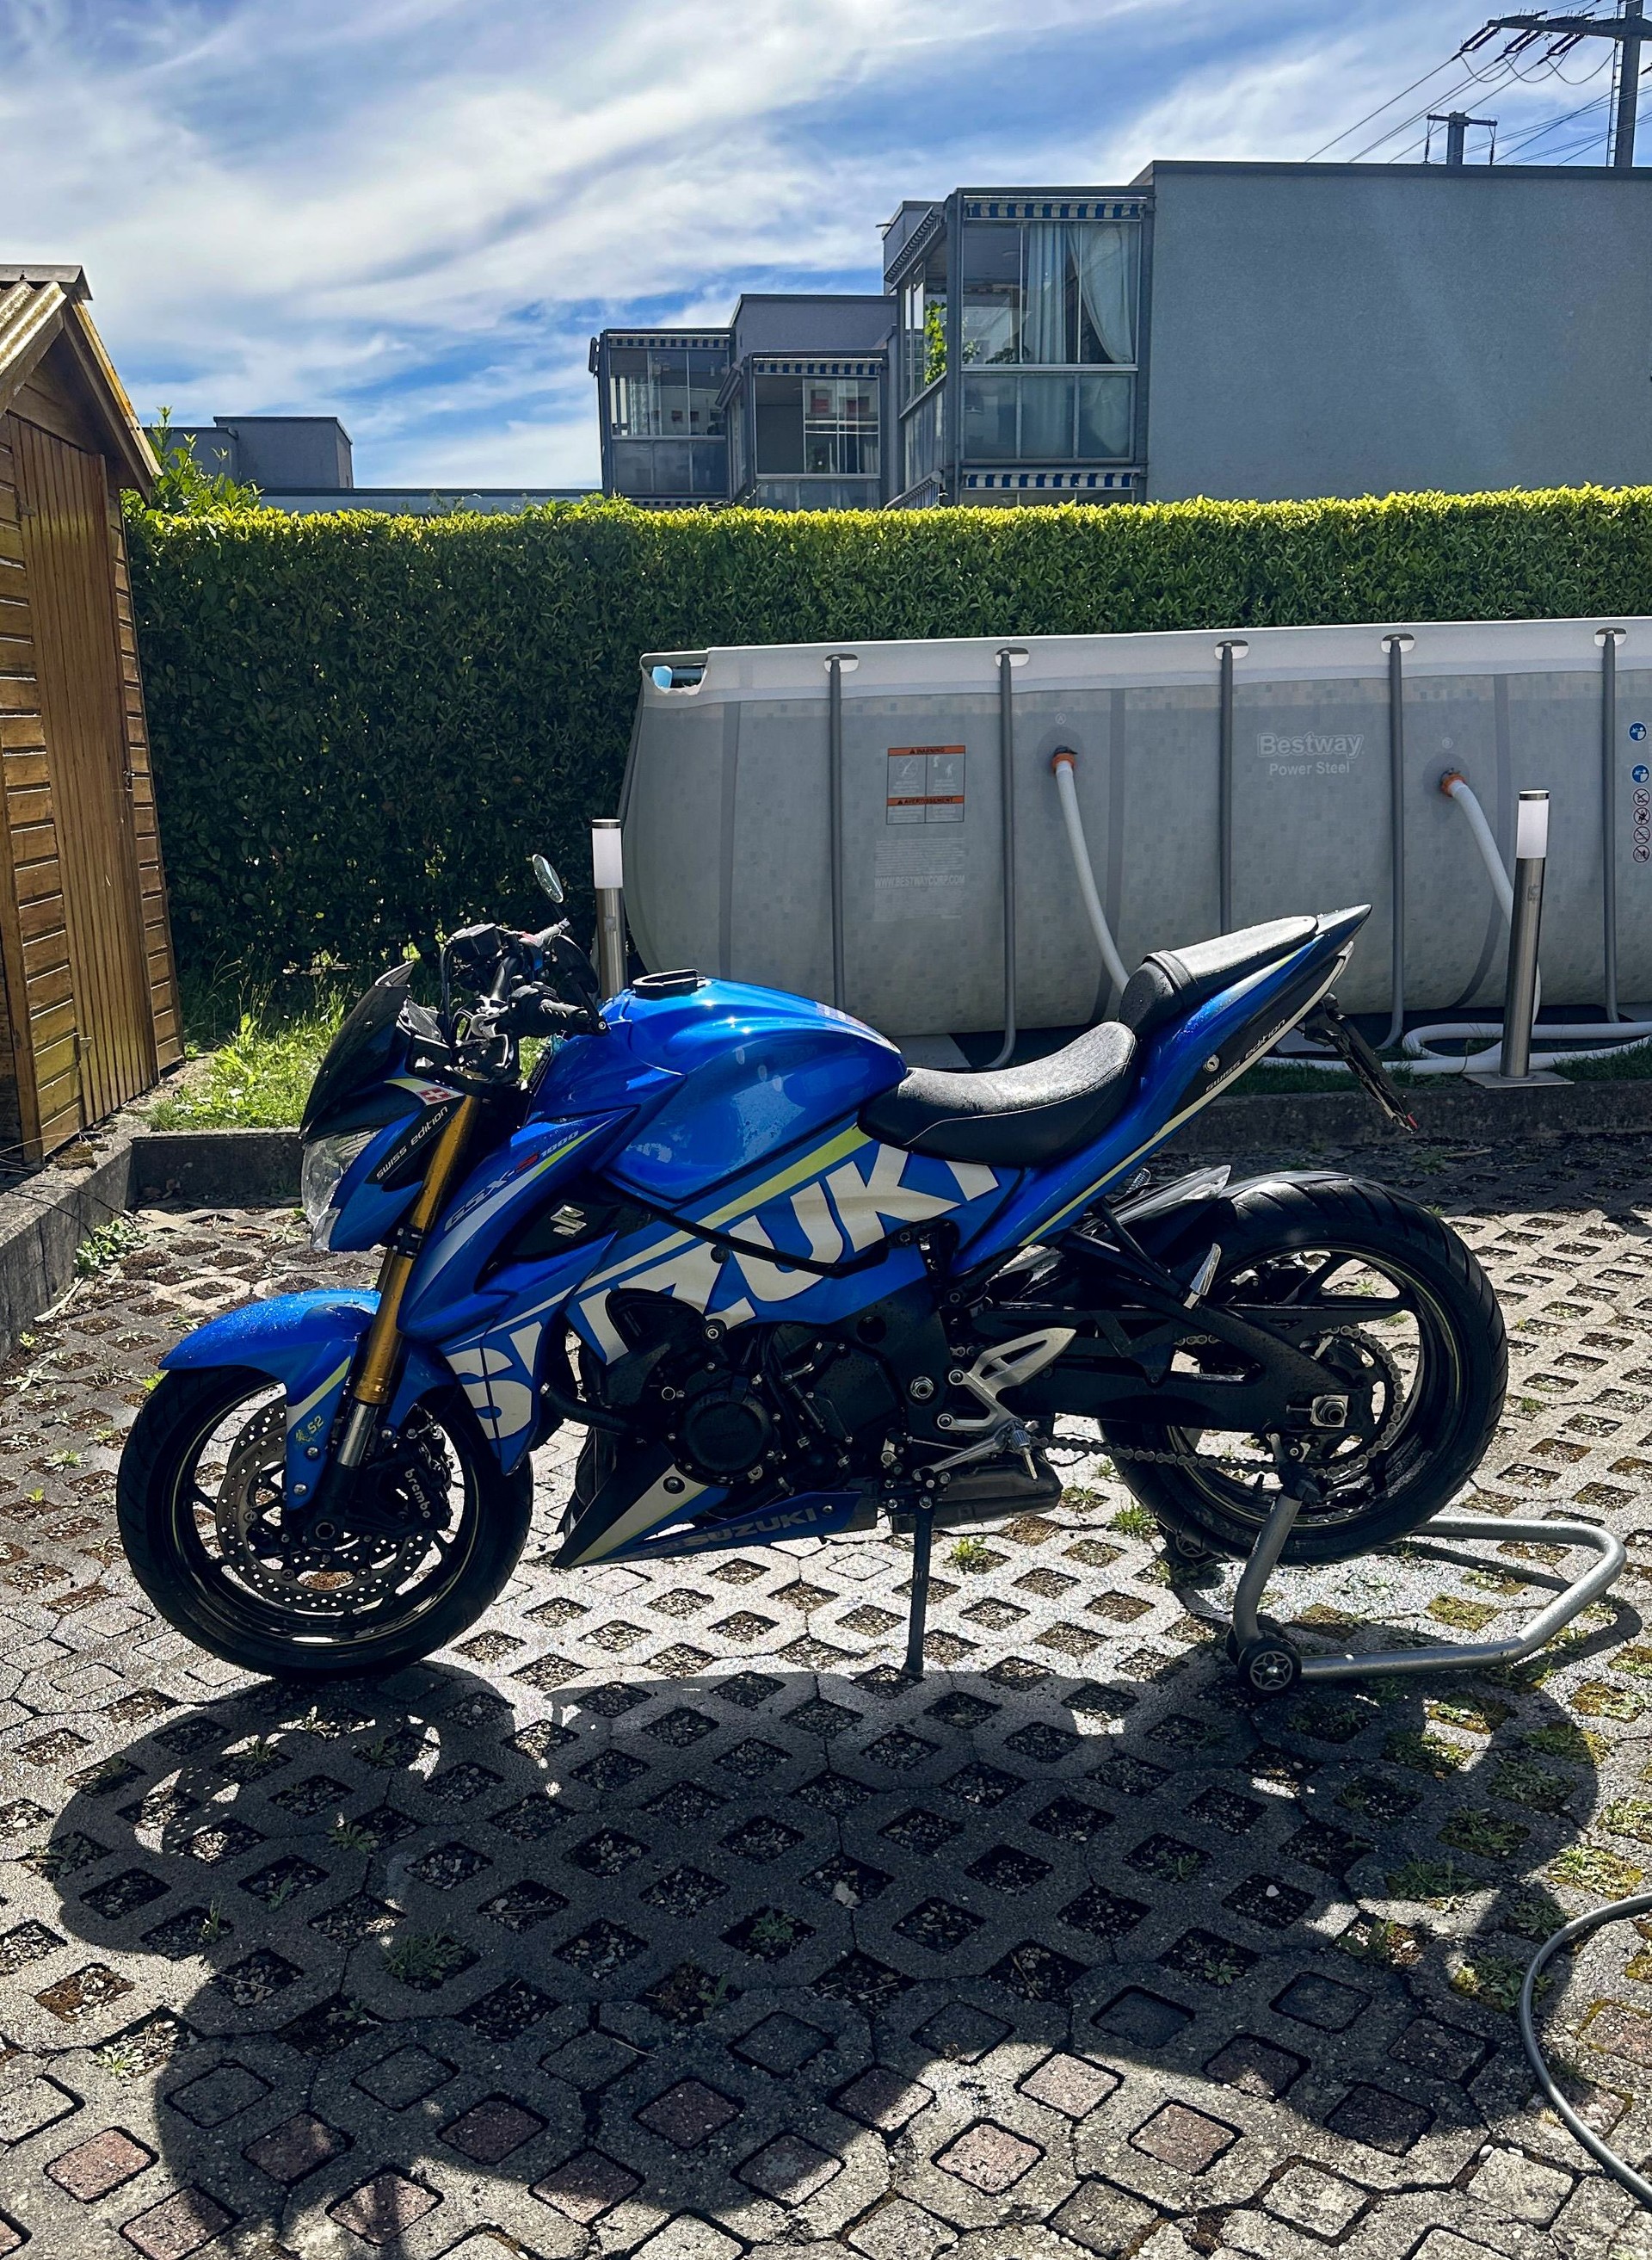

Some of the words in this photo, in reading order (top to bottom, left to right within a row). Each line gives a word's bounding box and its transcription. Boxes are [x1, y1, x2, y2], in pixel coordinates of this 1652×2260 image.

[1258, 732, 1364, 758] Bestway
[1269, 763, 1312, 775] Power
[1316, 761, 1350, 775] Steel
[874, 874, 965, 888] WWW.BESTWAYCORP.COM
[376, 1145, 407, 1180] swiss
[410, 1106, 448, 1145] edition
[404, 1467, 431, 1519] brembo
[683, 1507, 817, 1546] SUZUKI
